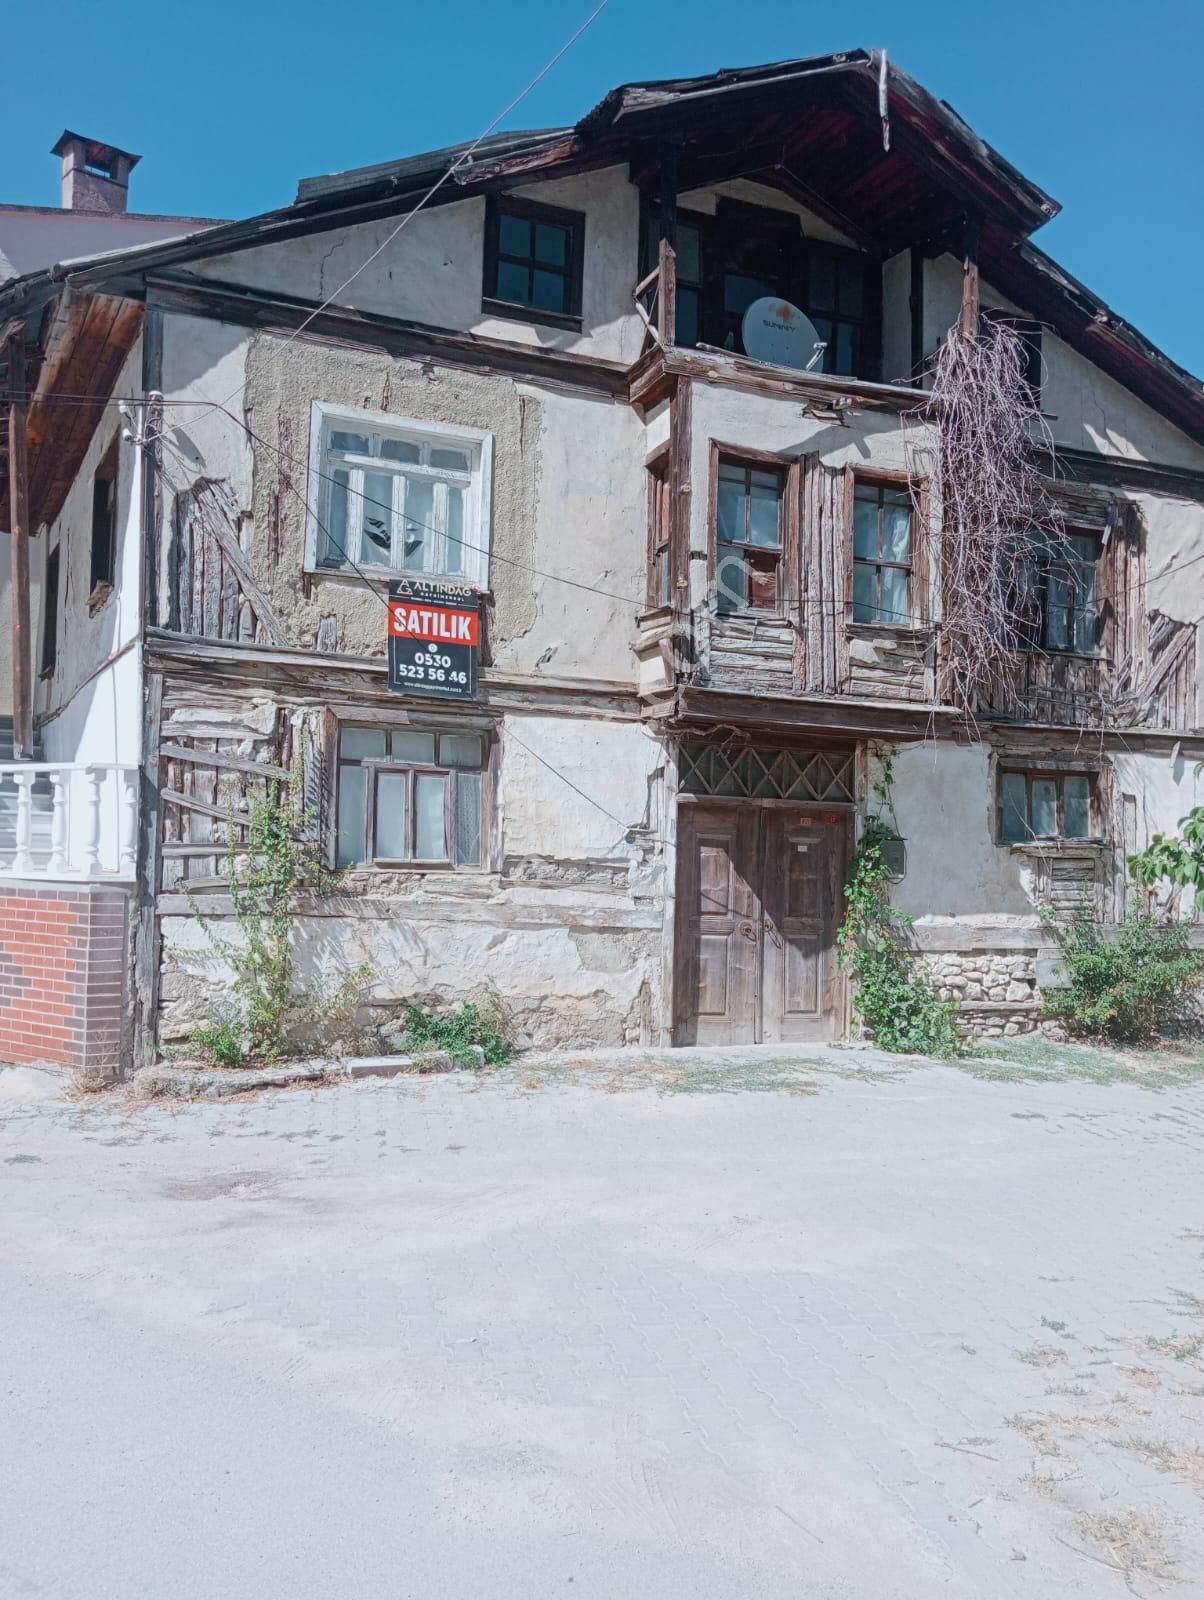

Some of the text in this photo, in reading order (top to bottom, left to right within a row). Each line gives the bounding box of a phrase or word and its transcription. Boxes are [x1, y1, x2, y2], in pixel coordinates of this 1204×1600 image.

[393, 607, 472, 640] SATILIK
[414, 652, 452, 668] 0530
[399, 664, 468, 684] 523 56 46
